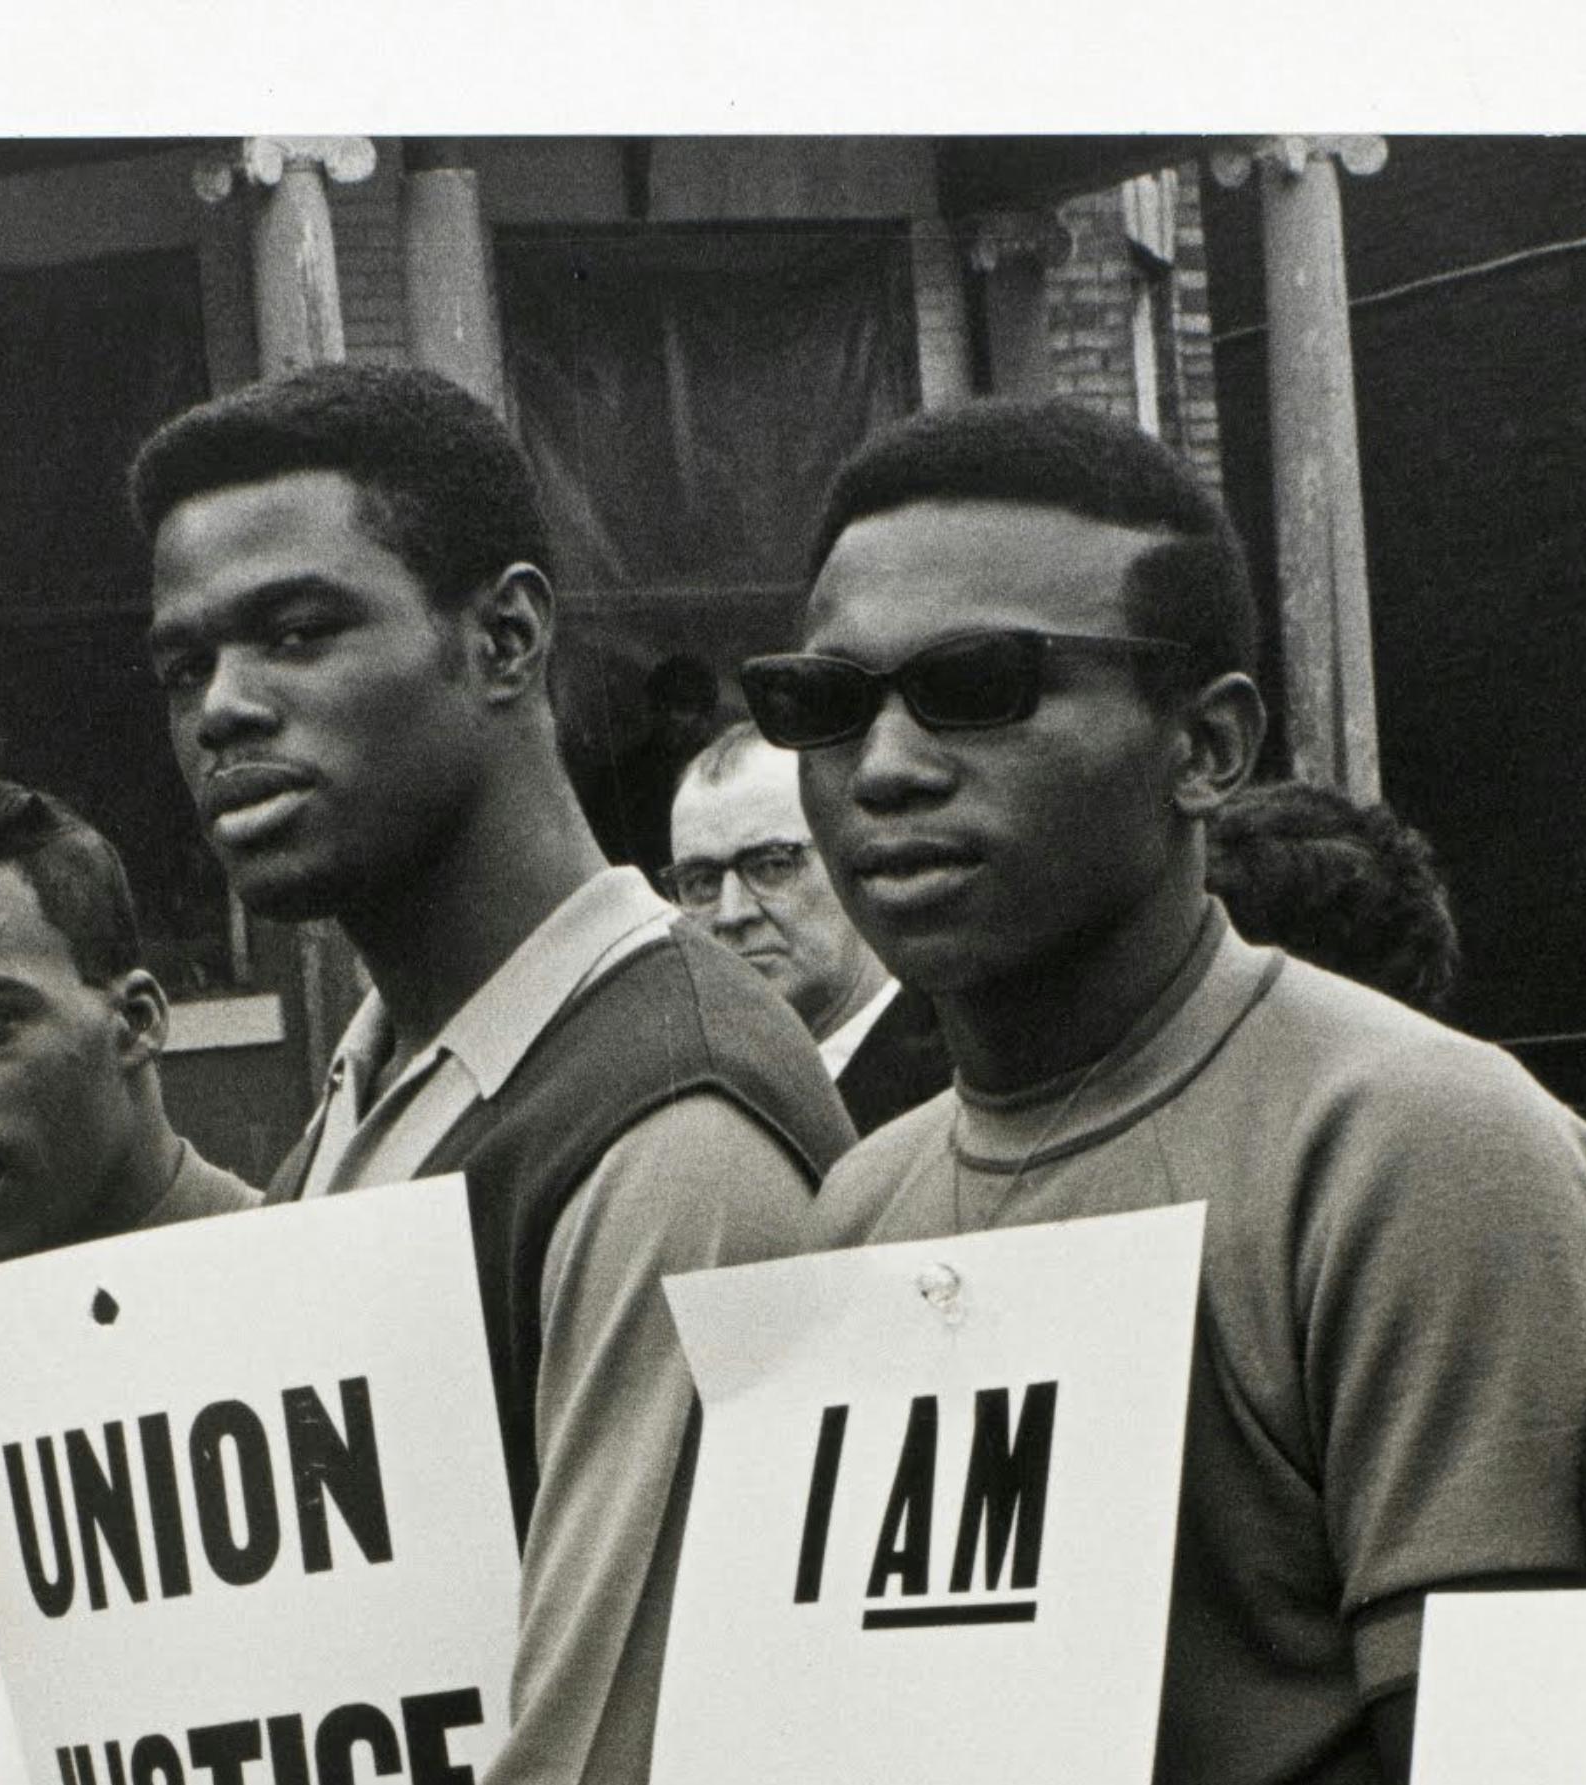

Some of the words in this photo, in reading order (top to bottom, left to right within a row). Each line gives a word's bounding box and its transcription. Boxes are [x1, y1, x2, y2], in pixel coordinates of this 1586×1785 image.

[4, 1376, 393, 1618] UNION
[794, 1405, 849, 1604] I
[866, 1381, 1058, 1598] AM
